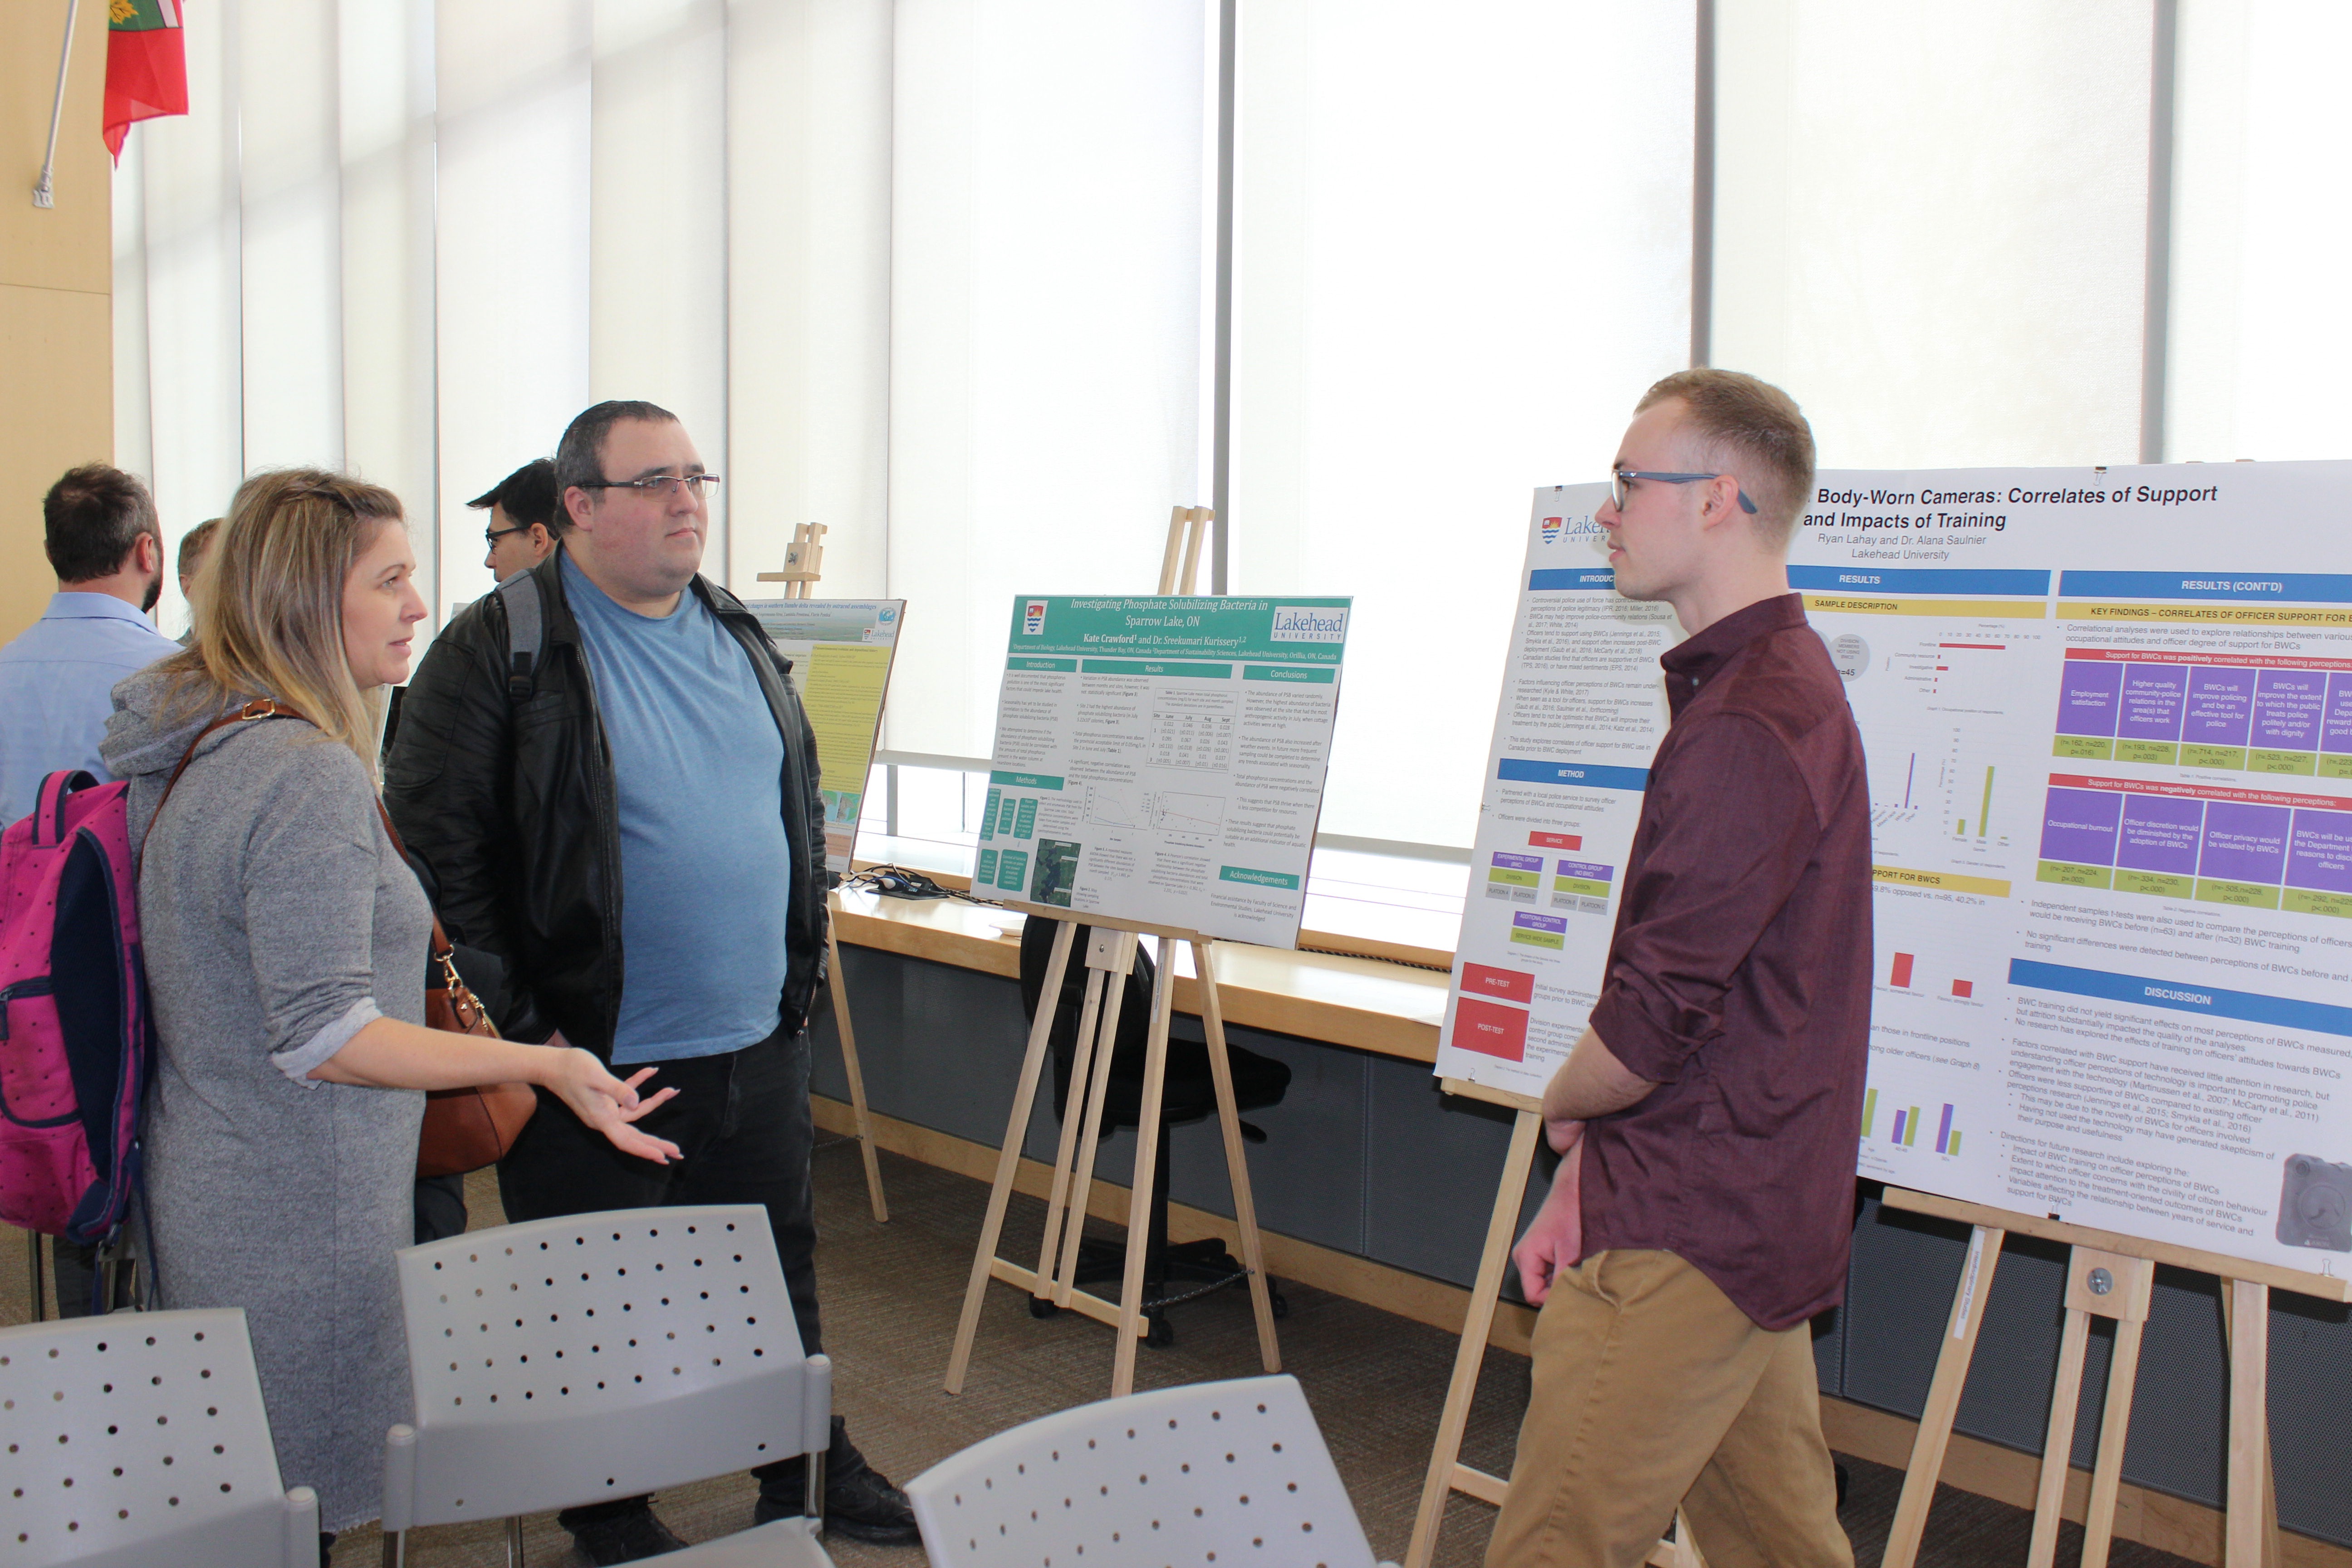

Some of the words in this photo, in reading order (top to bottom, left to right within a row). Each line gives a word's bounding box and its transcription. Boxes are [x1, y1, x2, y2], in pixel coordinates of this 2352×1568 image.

[1818, 489, 1914, 508] Body-Worn
[1921, 489, 2001, 505] Cameras:
[2008, 487, 2105, 503] Correlates
[2112, 486, 2132, 503] of
[2136, 485, 2218, 506] Support
[1564, 515, 1610, 535] Lake
[1803, 512, 1835, 526] and
[1841, 512, 1909, 531] Impacts
[1915, 513, 1932, 528] of
[1937, 512, 2006, 531] Training
[1818, 533, 1843, 545] Ryan
[1846, 534, 1877, 546] Lahay
[1879, 535, 1898, 545] and
[1901, 535, 1914, 545] Dr.
[1916, 535, 1943, 545] Alana
[1946, 535, 1986, 545] Saulnier
[1852, 549, 1900, 559] Lakehead
[1903, 550, 1949, 561] University
[1839, 575, 1880, 584] RESULTS
[2181, 581, 2230, 590] RESULTS
[2233, 582, 2282, 593] (CONT'D)
[1071, 598, 1122, 611] Investigating
[1123, 598, 1167, 612] Phosphate
[1168, 598, 1219, 612] Solubilizing
[1219, 599, 1256, 610] Bacteria
[1258, 600, 1268, 610] in
[1847, 602, 1897, 610] DESCRIPTION
[1125, 615, 1162, 628] Sparrow
[1163, 615, 1184, 628] Lake,
[1186, 616, 1200, 627] ON
[2110, 608, 2149, 616] FINDINGS
[2158, 609, 2218, 618] CORRELATES
[2235, 611, 2275, 619] OFFICER
[2278, 612, 2323, 621] SUPPORT
[2325, 614, 2346, 622] FOR
[1274, 612, 1343, 632] Lakehead
[2067, 624, 2113, 632] Correlational
[2114, 626, 2148, 635] analyses
[2201, 628, 2230, 637] explore
[2233, 629, 2283, 639] relationships
[2286, 631, 2322, 639] between
[1083, 633, 1100, 642] Kate
[1138, 635, 1152, 644] and
[1152, 635, 1162, 644] Dr.
[1163, 635, 1203, 645] Sreekumari
[2188, 639, 2216, 648] degree
[2228, 641, 2259, 649] support
[2274, 641, 2300, 650] BWCs
[1076, 645, 1098, 653] University,
[1185, 648, 1216, 657] Sustainability
[1263, 651, 1288, 659] University,
[1270, 670, 1307, 679] Conclusions
[1015, 776, 1037, 784] Methods
[1558, 769, 1584, 778] METHOD
[2088, 779, 2113, 787] Support
[2124, 782, 2144, 790] BWCs
[2160, 786, 2196, 795] negatively
[2260, 794, 2291, 804] following
[2292, 797, 2336, 806] perceptions:
[1229, 870, 1288, 885] Acknowledgements
[1917, 875, 1940, 884] BWCS
[1237, 913, 1265, 922] acknowledged
[2031, 900, 2077, 912] Independent
[2078, 907, 2109, 916] samples
[2111, 910, 2134, 920] t-tests
[2156, 916, 2173, 924] also
[2205, 923, 2241, 933] compare
[2243, 926, 2256, 935] the
[2258, 930, 2308, 942] perceptions
[2320, 937, 2352, 948] officers
[1485, 977, 1510, 987] PRE-TEST
[2144, 986, 2211, 1004] DISCUSSION
[1478, 1023, 1504, 1034] POST-TEST
